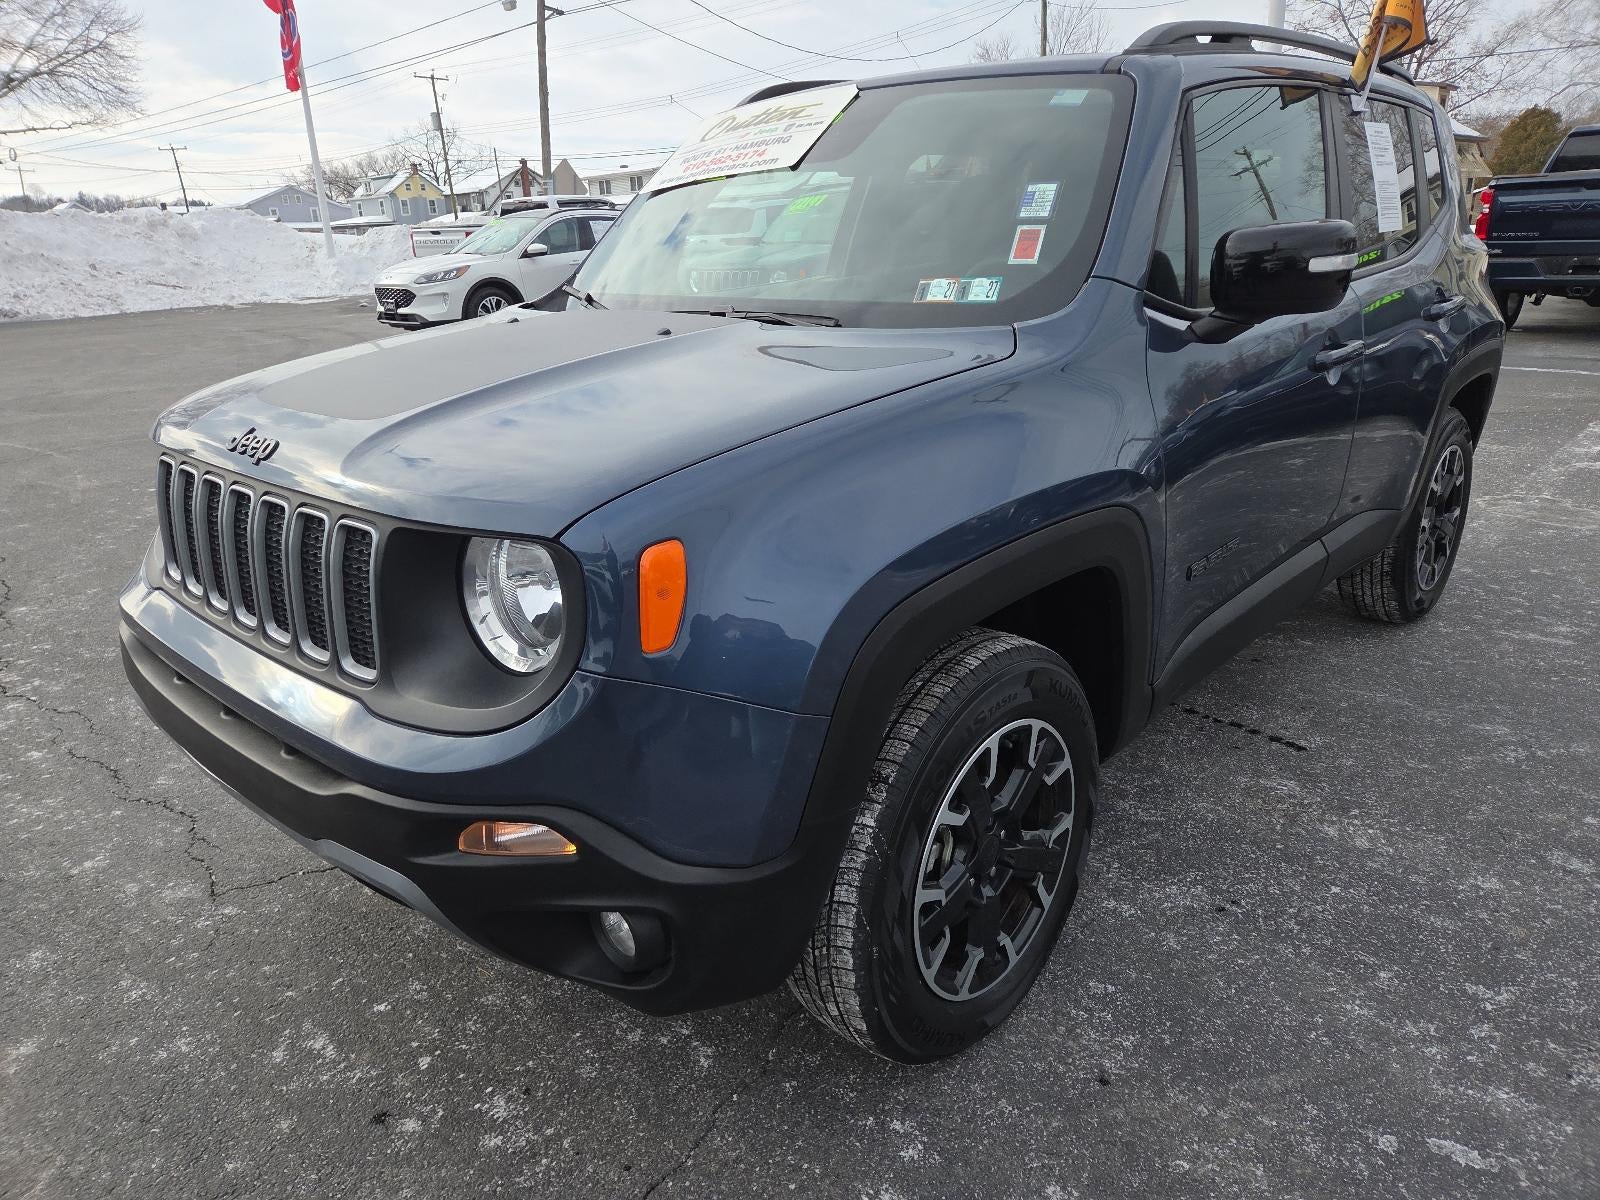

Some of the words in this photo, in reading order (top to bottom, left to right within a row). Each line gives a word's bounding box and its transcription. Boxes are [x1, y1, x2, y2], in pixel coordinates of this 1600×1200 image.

[731, 135, 792, 151] HAMBURG
[943, 281, 957, 299] 27
[985, 280, 999, 299] 27
[225, 426, 280, 466] Jeep
